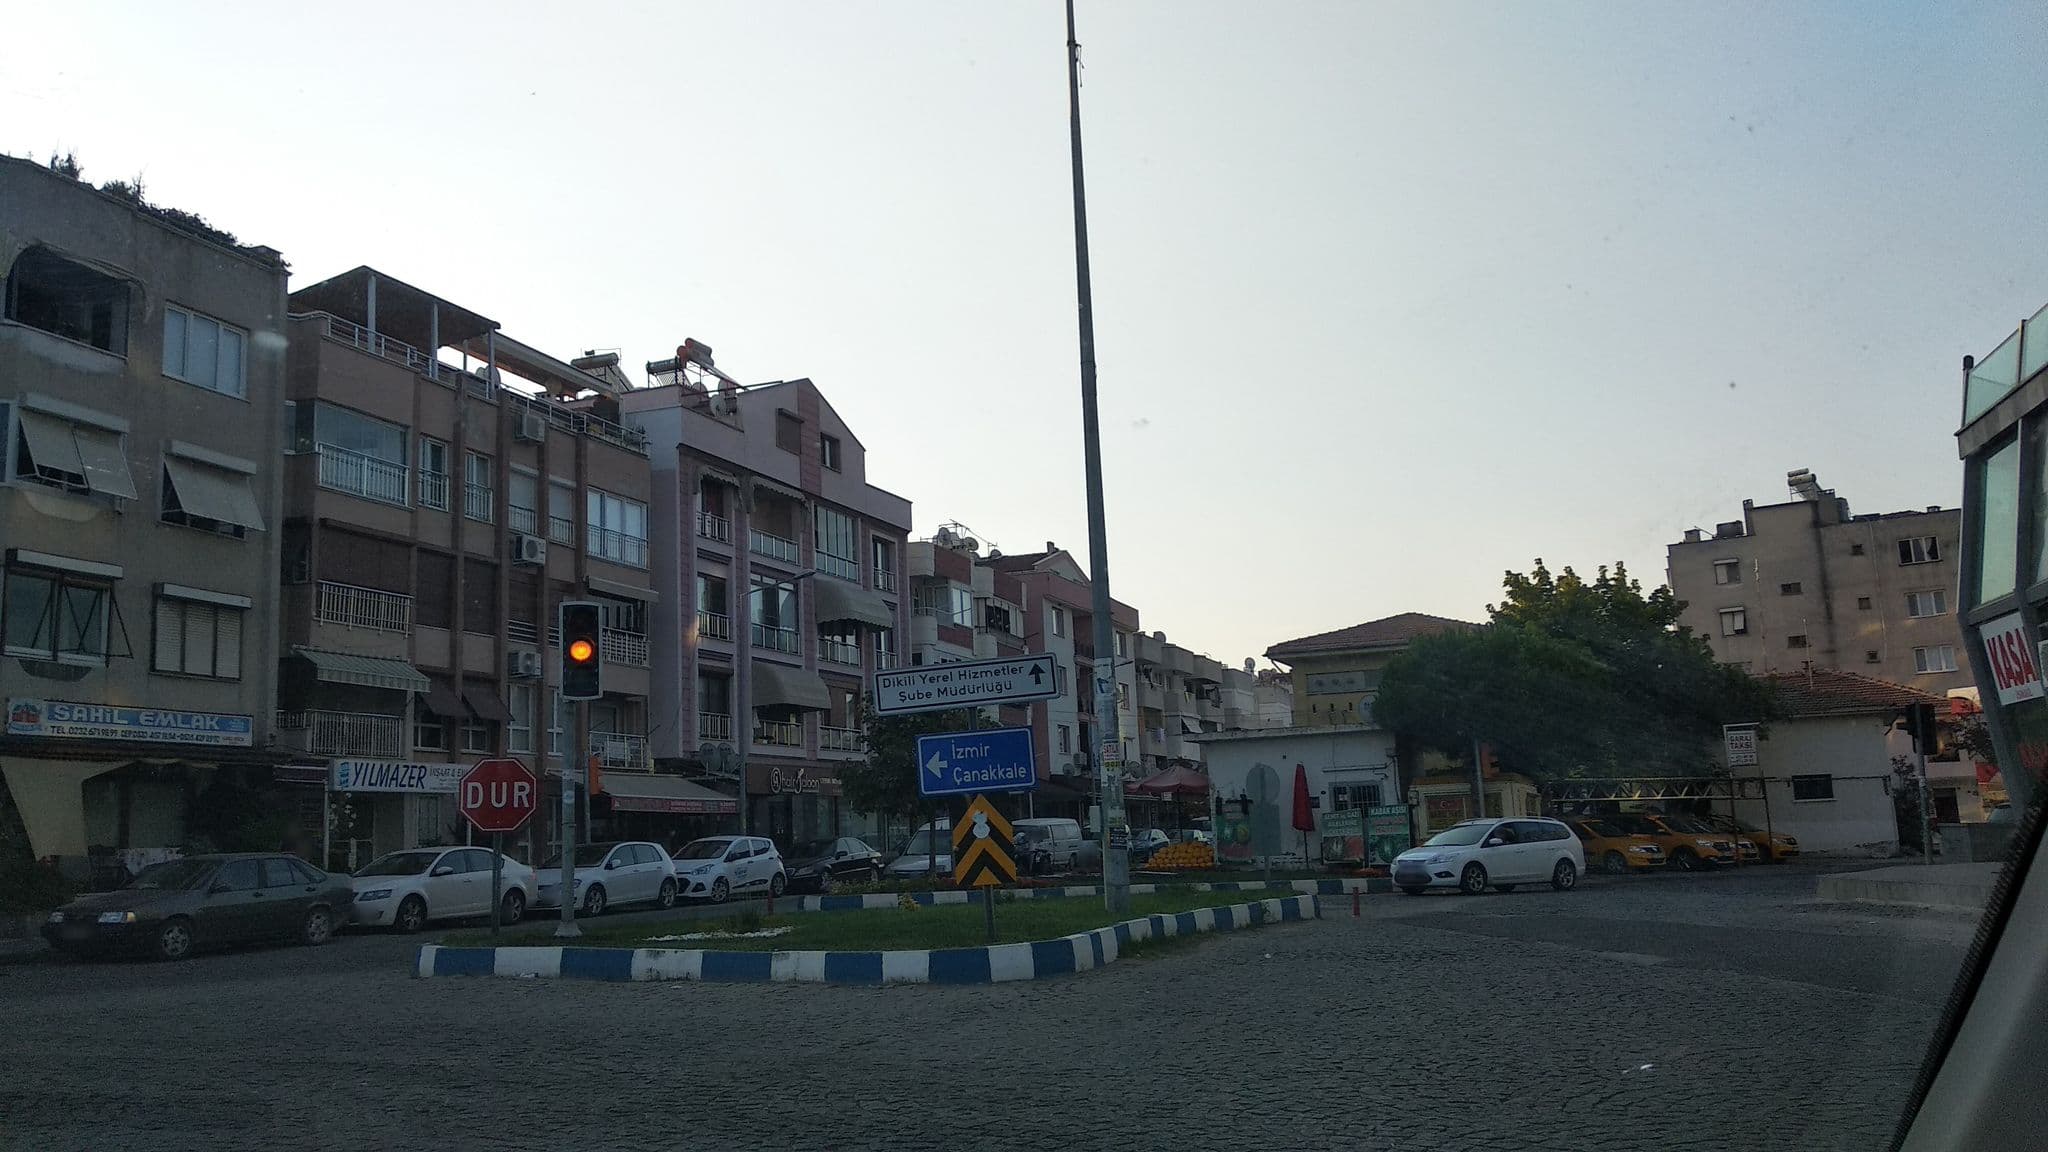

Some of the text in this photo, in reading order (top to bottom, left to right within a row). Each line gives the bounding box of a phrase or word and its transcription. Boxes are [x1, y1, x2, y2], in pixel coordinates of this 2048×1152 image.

[1986, 628, 2038, 690] KASA
[883, 665, 1024, 688] Dikili Yerel Hizmetler
[899, 681, 1012, 702] Şube Müdürlüğü
[139, 710, 219, 730] EMLAK
[951, 740, 990, 760] İzmir
[352, 762, 427, 789] YILMAZER
[953, 762, 1026, 786] Çanakkale
[466, 781, 530, 809] DUR
